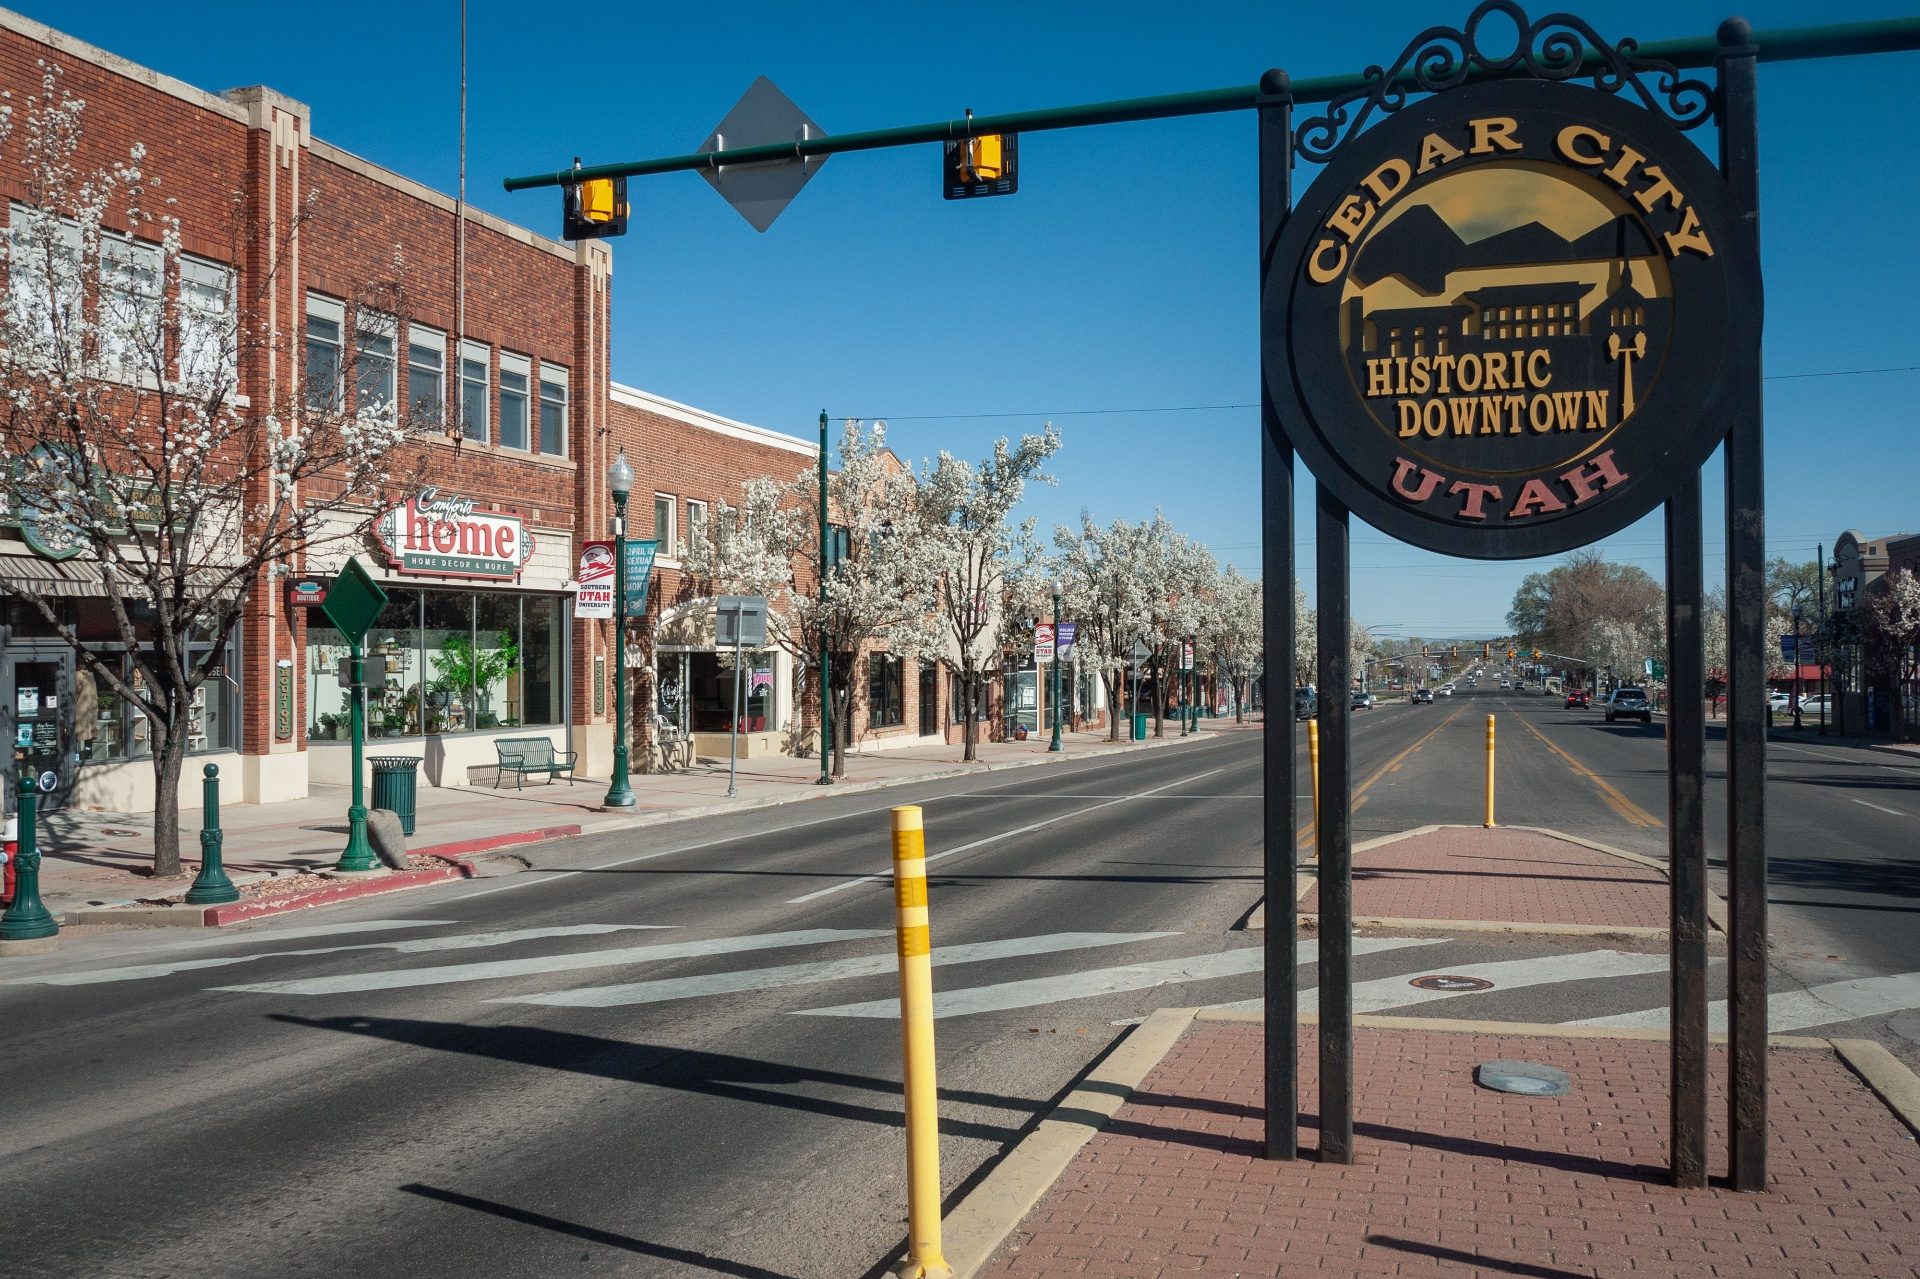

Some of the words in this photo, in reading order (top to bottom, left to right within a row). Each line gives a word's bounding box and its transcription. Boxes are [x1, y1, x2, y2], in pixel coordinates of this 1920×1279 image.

[1308, 117, 1522, 284] CEDAR
[1556, 125, 1715, 259] CITY
[1366, 350, 1552, 397] HISTORIC
[1398, 390, 1609, 438] DOWNTOWN
[1391, 449, 1629, 519] UTAH
[418, 488, 480, 523] Comforts
[403, 497, 515, 559] home
[411, 557, 437, 567] HOME
[441, 560, 471, 568] DECOR
[475, 561, 480, 569] &
[484, 561, 507, 571] MORE
[627, 547, 646, 556] APRIL
[647, 547, 654, 555] IS
[626, 581, 647, 591] MONT
[627, 566, 649, 574] ASSAU
[296, 594, 320, 602] BOUTIQUE
[579, 591, 611, 602] UTAH
[279, 667, 289, 735] BOUTIQUE
